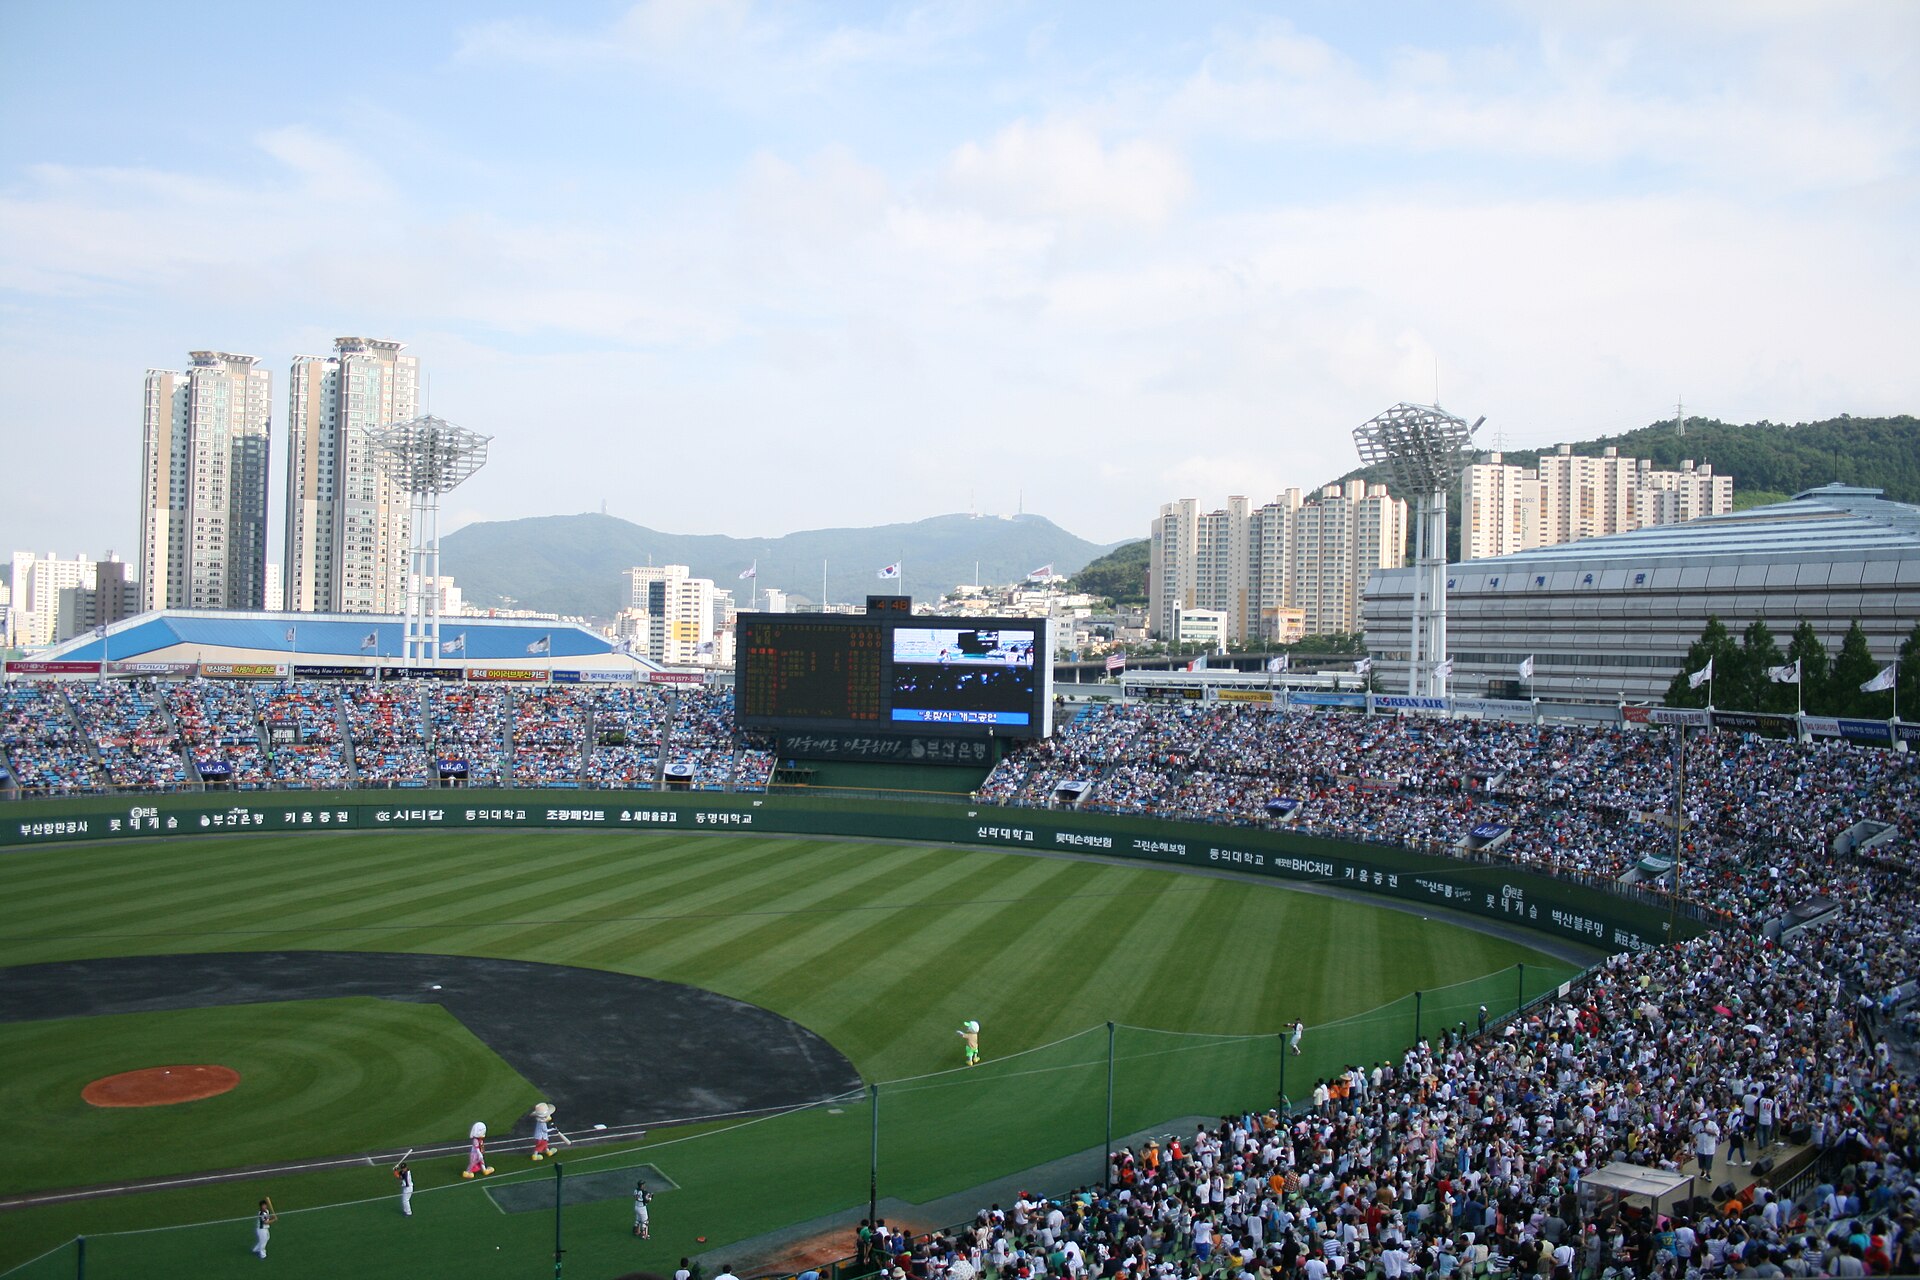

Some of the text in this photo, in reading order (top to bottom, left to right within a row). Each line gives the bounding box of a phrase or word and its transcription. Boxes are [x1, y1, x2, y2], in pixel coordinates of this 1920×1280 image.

[471, 669, 487, 678] 롯데
[590, 673, 633, 681] 롯데손해보험
[1375, 696, 1420, 707] KOREAN
[1422, 698, 1444, 708] AIR
[786, 735, 986, 759] 가을에도 야구하자 부산은행
[214, 813, 264, 826] 부산은행
[286, 811, 348, 824] 키움증권
[393, 810, 445, 821] 시티캅
[465, 809, 526, 821] 동의대학교
[547, 809, 605, 821] 조광페인트
[633, 811, 677, 822] 새마을금고
[695, 812, 752, 824] 동명대학교
[21, 821, 88, 836] 부산항만공사
[111, 816, 178, 831] 롯데캐슬
[977, 826, 1034, 841] 신라대학교
[1056, 833, 1112, 848] 롯데손해보험
[1133, 839, 1186, 855] 그린손해보험
[1210, 848, 1264, 866] 동의대학교
[1345, 866, 1398, 888] 키움증권
[1486, 893, 1538, 919] 롯데캐슬
[1551, 909, 1604, 938] 벽산블루밍
